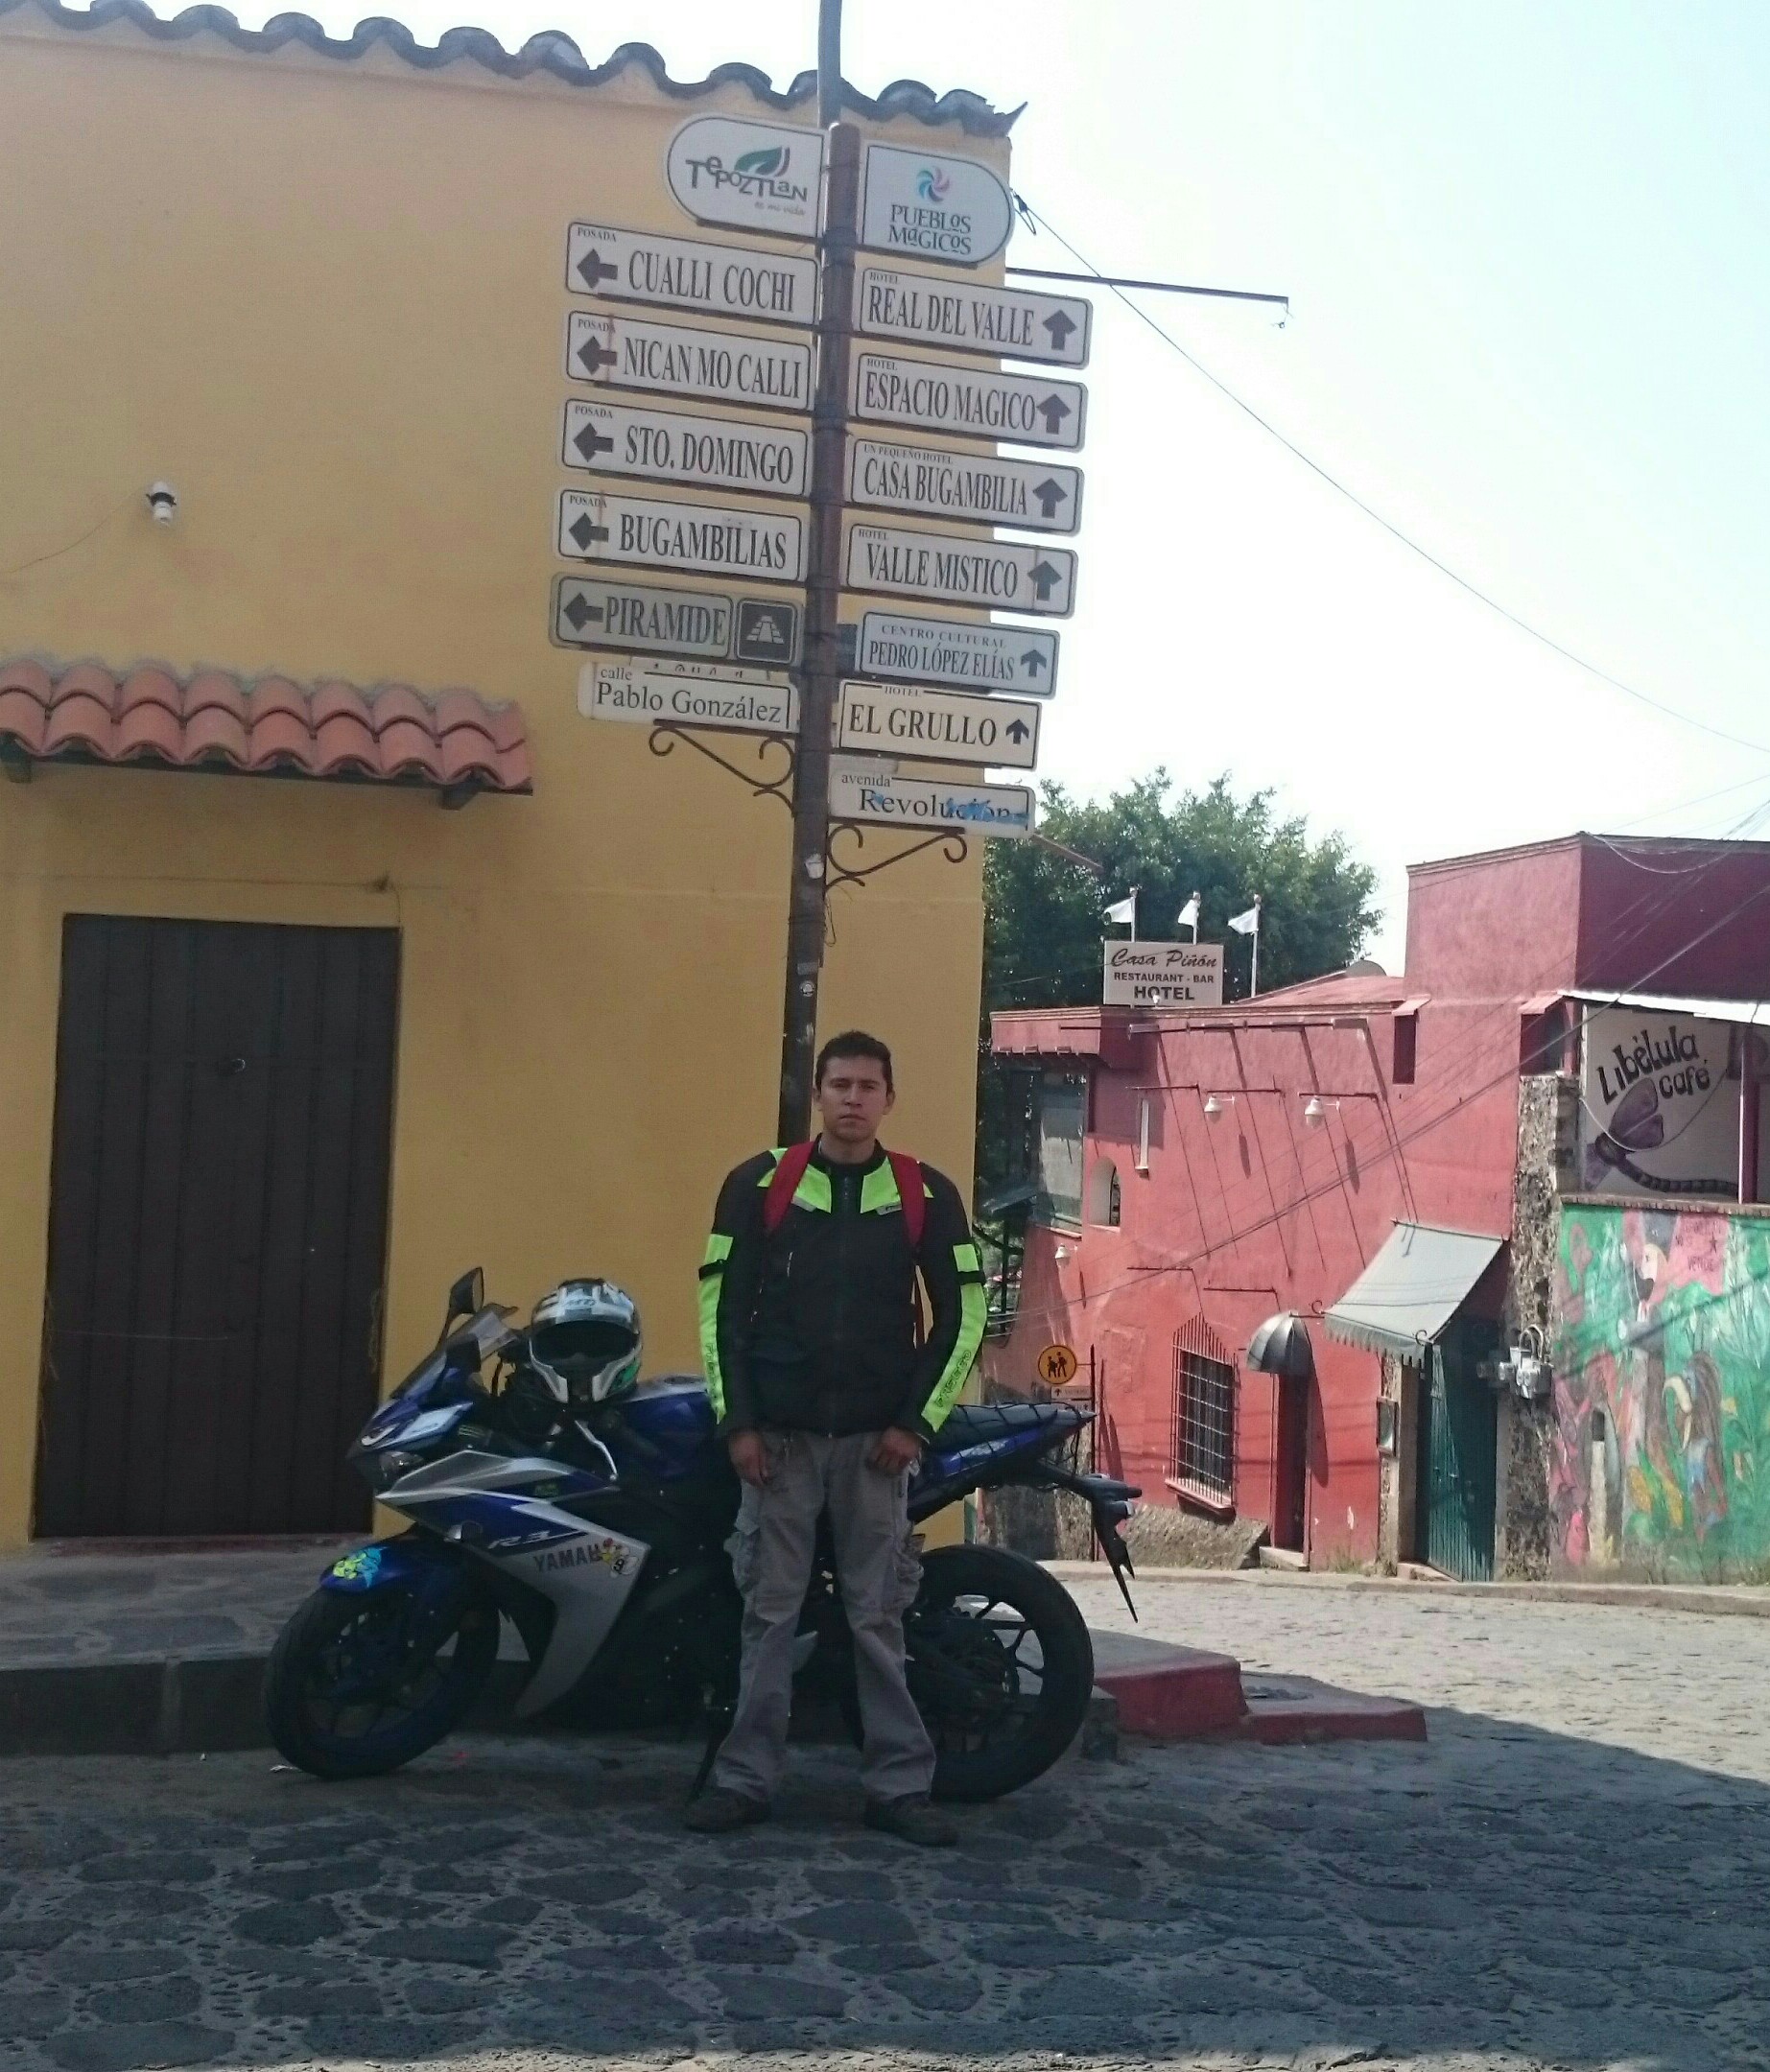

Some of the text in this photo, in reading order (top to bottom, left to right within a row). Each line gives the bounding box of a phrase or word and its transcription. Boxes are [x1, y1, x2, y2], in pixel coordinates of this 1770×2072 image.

[578, 227, 617, 243] POSADA
[628, 250, 796, 313] CUALLI COCHI
[869, 271, 899, 284] HOTEL
[578, 318, 617, 334] POSADA
[868, 286, 1034, 346] REAL DEL VALLE
[624, 337, 802, 399] NICAN MO CALLI
[866, 358, 897, 370] HOTEL
[575, 405, 613, 419] POSADA
[865, 372, 1037, 431] ESPACIO MAGICO
[625, 425, 793, 484] STO. DOMINGO
[923, 452, 953, 465] HOTEL
[864, 458, 1027, 515] CASA BUGAMBILIA
[570, 495, 607, 508] POSADA
[619, 513, 787, 569] BUGAMBILIAS
[858, 528, 889, 541] HOTEL
[866, 543, 1018, 599] VALLE MISTICO
[604, 596, 726, 647] PIRAMIDE
[882, 624, 1006, 648] CENTRO CULTURAL
[869, 640, 1015, 682] PEDRO LÓPEZ ELÍAS
[601, 667, 633, 681] calle
[884, 685, 921, 697] HOTEL
[597, 681, 782, 724] Pablo González
[849, 703, 997, 746] EL GRULLO
[841, 773, 891, 788] avenida
[1111, 948, 1159, 967] Casa
[1114, 972, 1184, 983] RESTAURANT
[1193, 975, 1215, 983] BAR
[1134, 986, 1195, 1001] HOTEL
[532, 1543, 606, 1573] YAMAH
